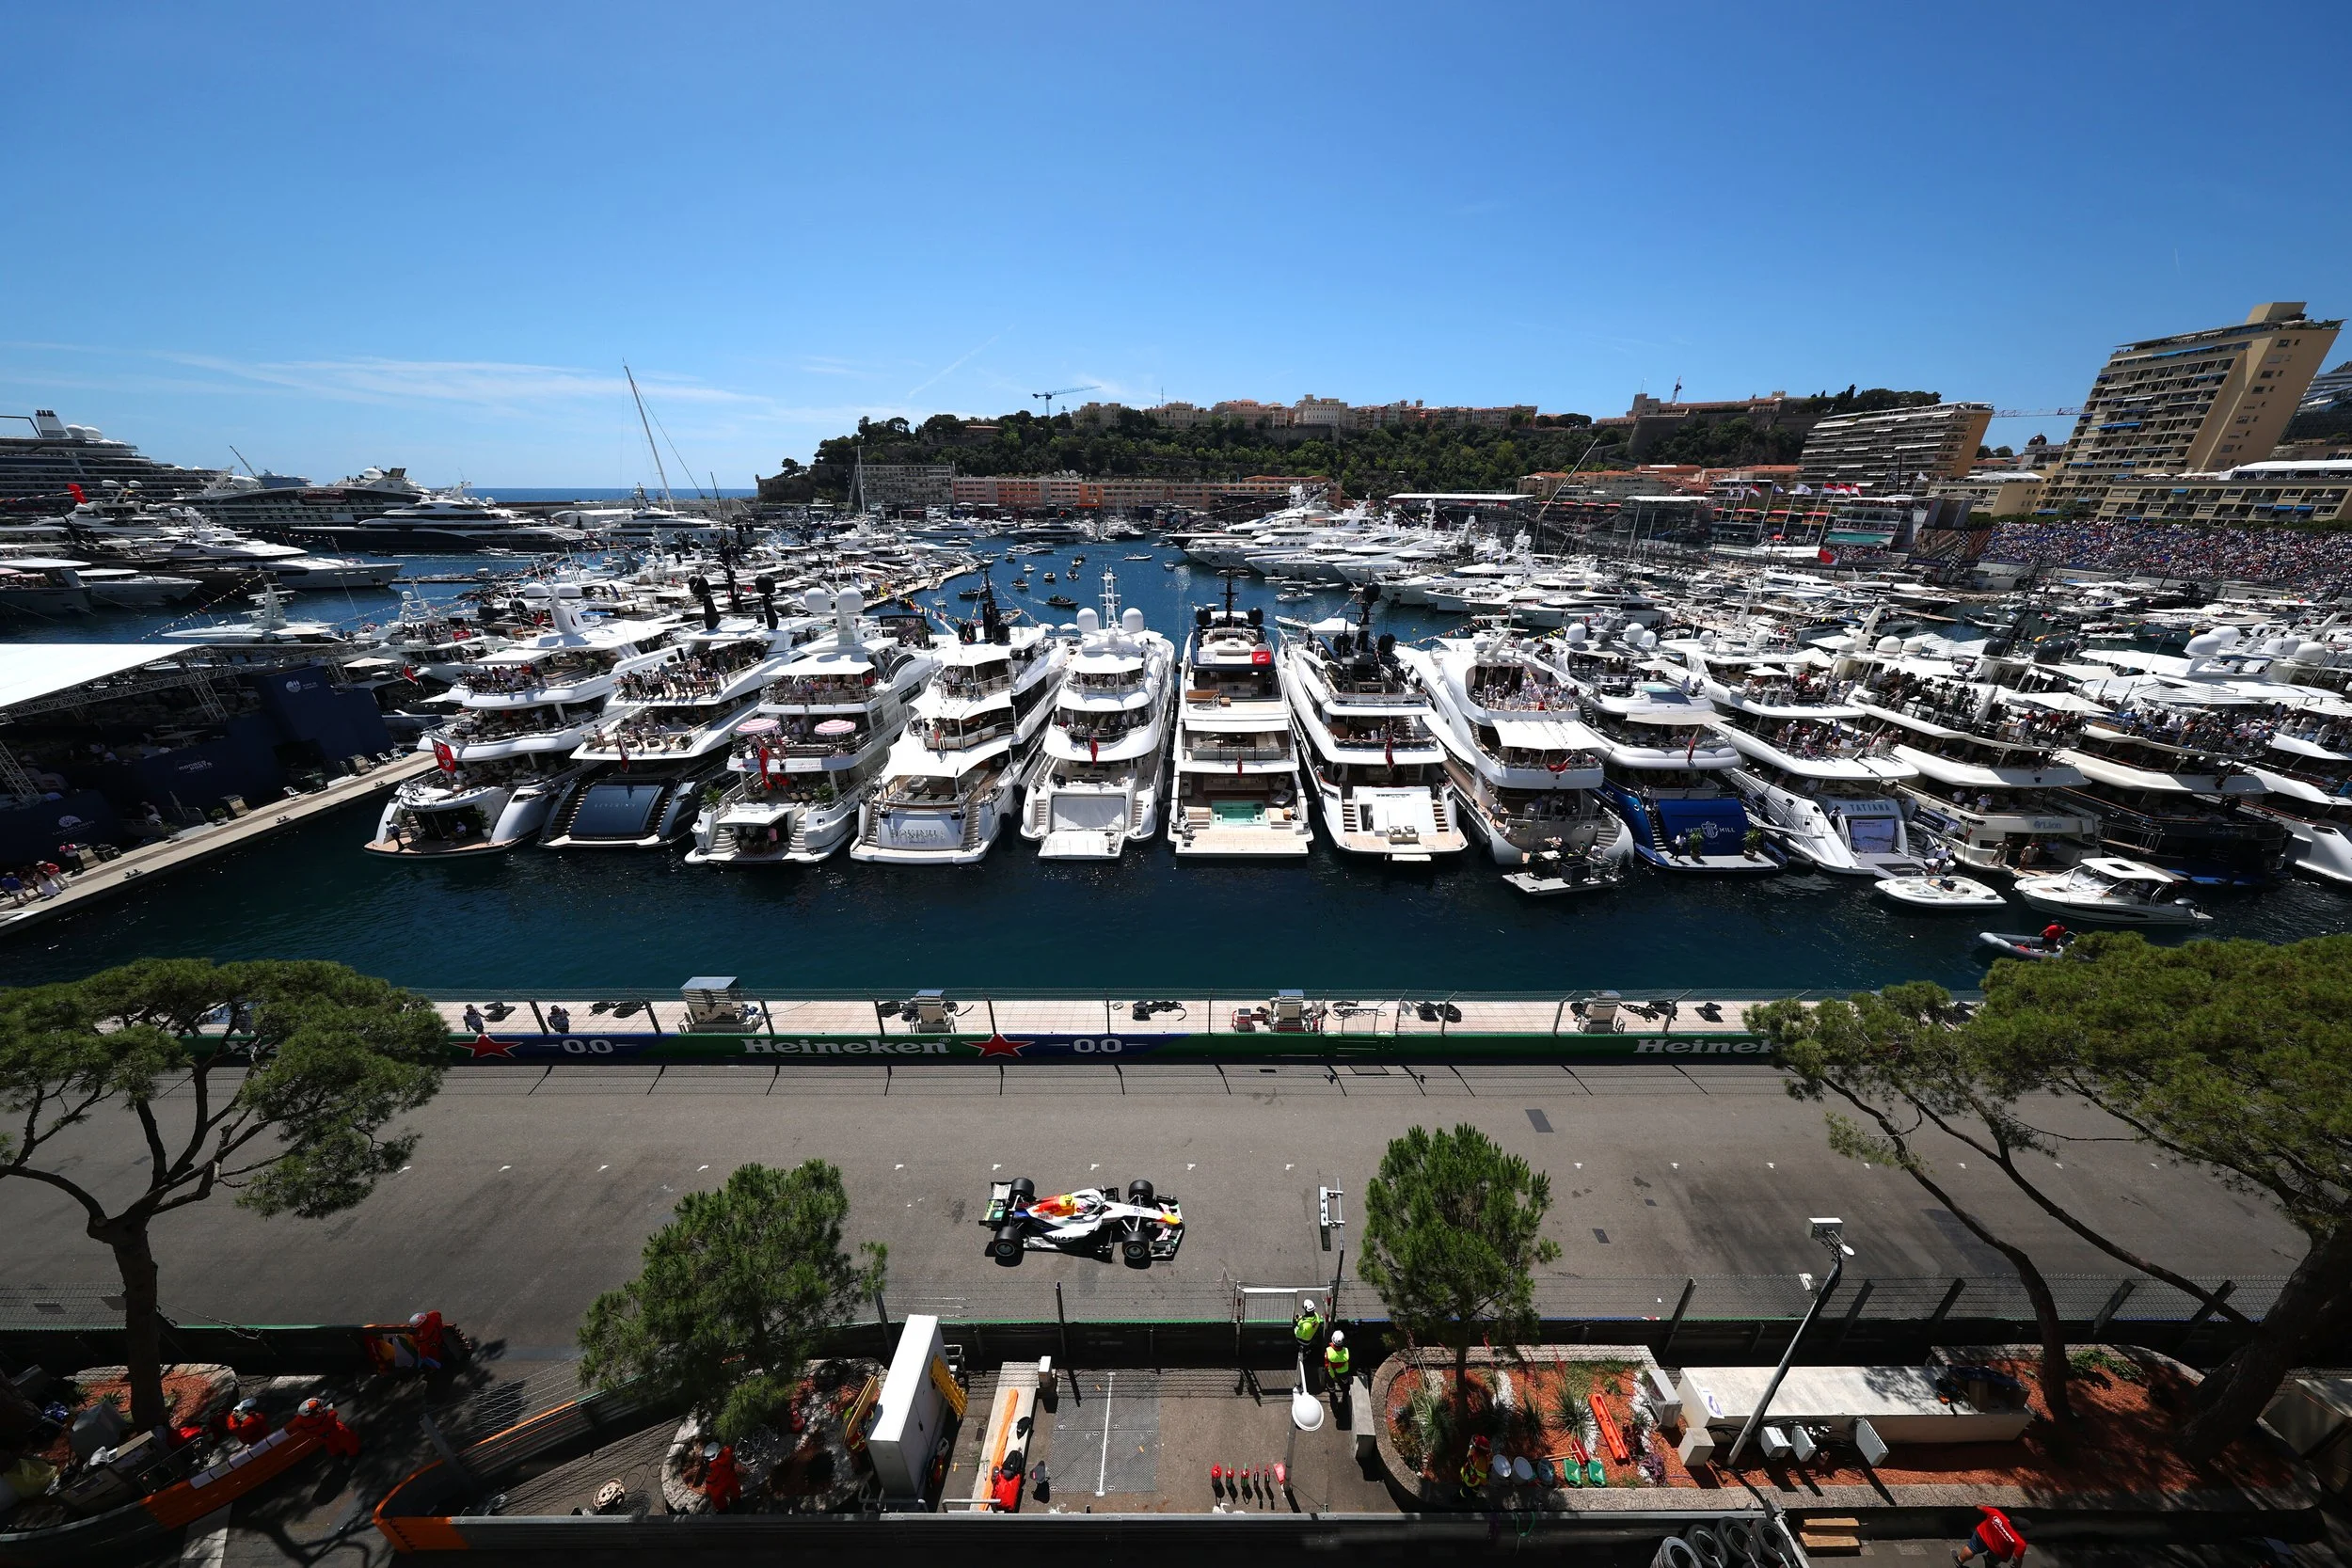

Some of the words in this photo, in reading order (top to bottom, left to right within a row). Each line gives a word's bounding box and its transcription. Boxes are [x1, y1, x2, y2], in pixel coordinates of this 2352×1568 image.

[1850, 803, 1891, 813] TATIANA
[562, 1039, 613, 1053] 0.0
[740, 1038, 950, 1054] Heineken
[1073, 1038, 1122, 1053] 0.0
[1633, 1038, 1785, 1053] Heinek
